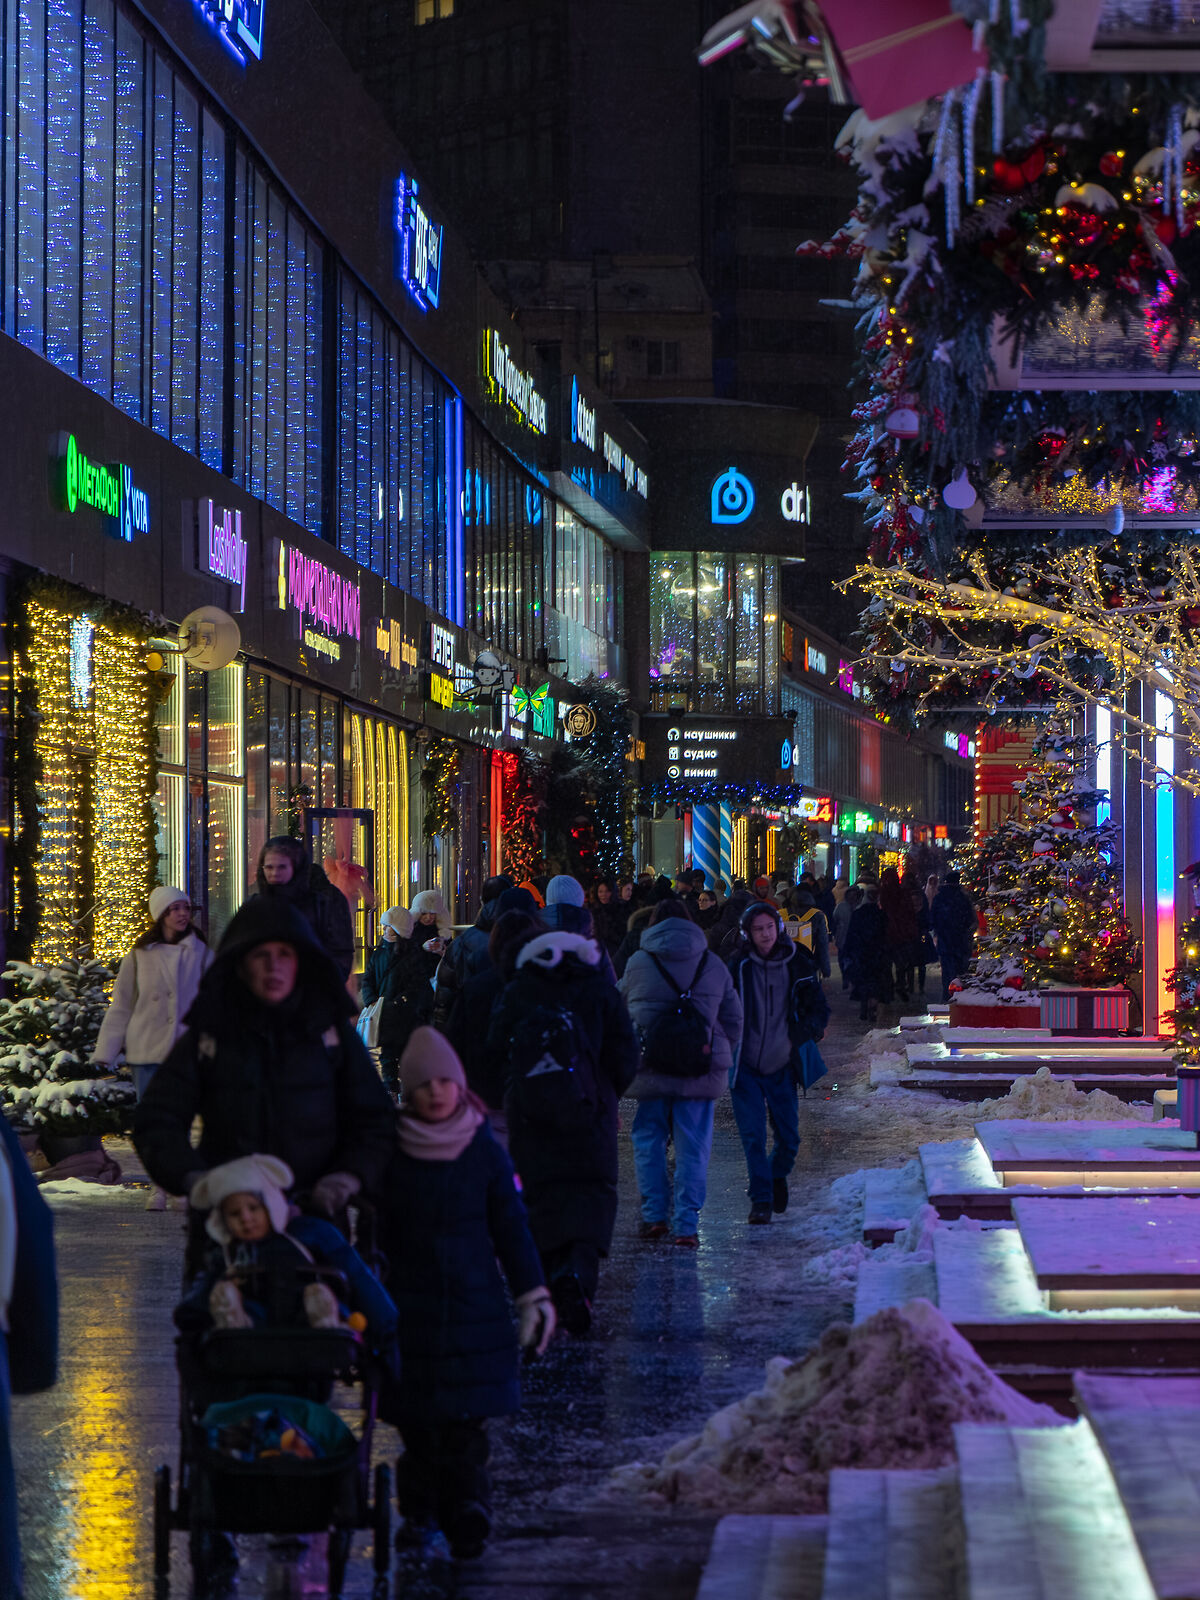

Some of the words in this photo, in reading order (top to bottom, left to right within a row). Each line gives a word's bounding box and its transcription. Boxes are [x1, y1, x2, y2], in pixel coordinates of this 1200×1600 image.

[683, 730, 737, 742] наушники
[683, 749, 718, 761] аудио
[683, 768, 718, 778] винил
